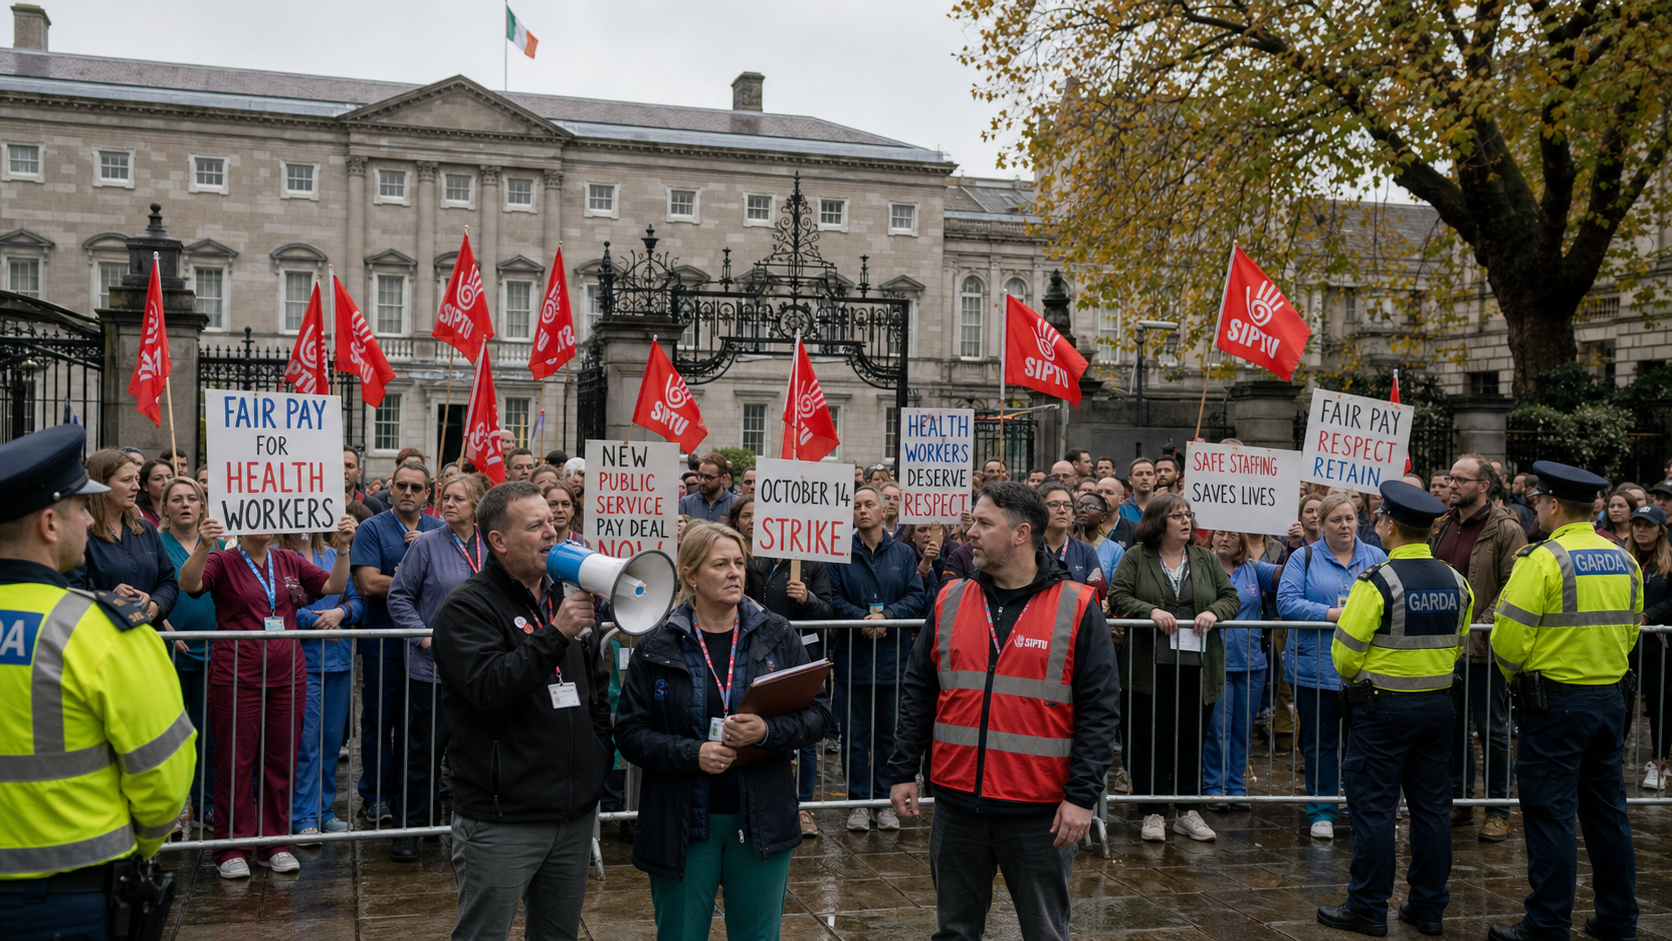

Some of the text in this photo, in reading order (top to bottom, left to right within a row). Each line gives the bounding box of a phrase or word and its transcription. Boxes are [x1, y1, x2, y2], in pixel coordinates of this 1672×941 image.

[439, 303, 474, 340] SIPTU
[1227, 318, 1280, 359] SIPTU
[1024, 356, 1069, 389] SIPTU
[224, 396, 327, 430] FAIR PAY
[651, 400, 690, 436] SIPTU
[1320, 399, 1402, 436] FAIR PAY
[908, 415, 969, 438] HEALTH
[256, 435, 289, 455] FOR
[602, 445, 648, 468] NEW
[904, 443, 969, 463] WORKERS
[1317, 430, 1397, 464] RESPECT
[1193, 451, 1278, 477] SAFE STAFFING
[1313, 456, 1381, 488] RETAIN
[226, 461, 324, 494] HEALTH
[599, 471, 656, 492] PUBLIC
[907, 468, 967, 488] DESERVE
[761, 478, 851, 507] OCTOBER 14
[1192, 482, 1276, 507] SAVES LIVES
[221, 498, 334, 531] WORKERS
[596, 495, 664, 516] SERVICE
[904, 493, 968, 517] RESPECT
[596, 518, 669, 538] PAY DEAL
[598, 539, 663, 558] NO
[1575, 553, 1627, 572] GARDA
[1409, 592, 1458, 611] GARDA
[1024, 638, 1048, 650] SIPTU
